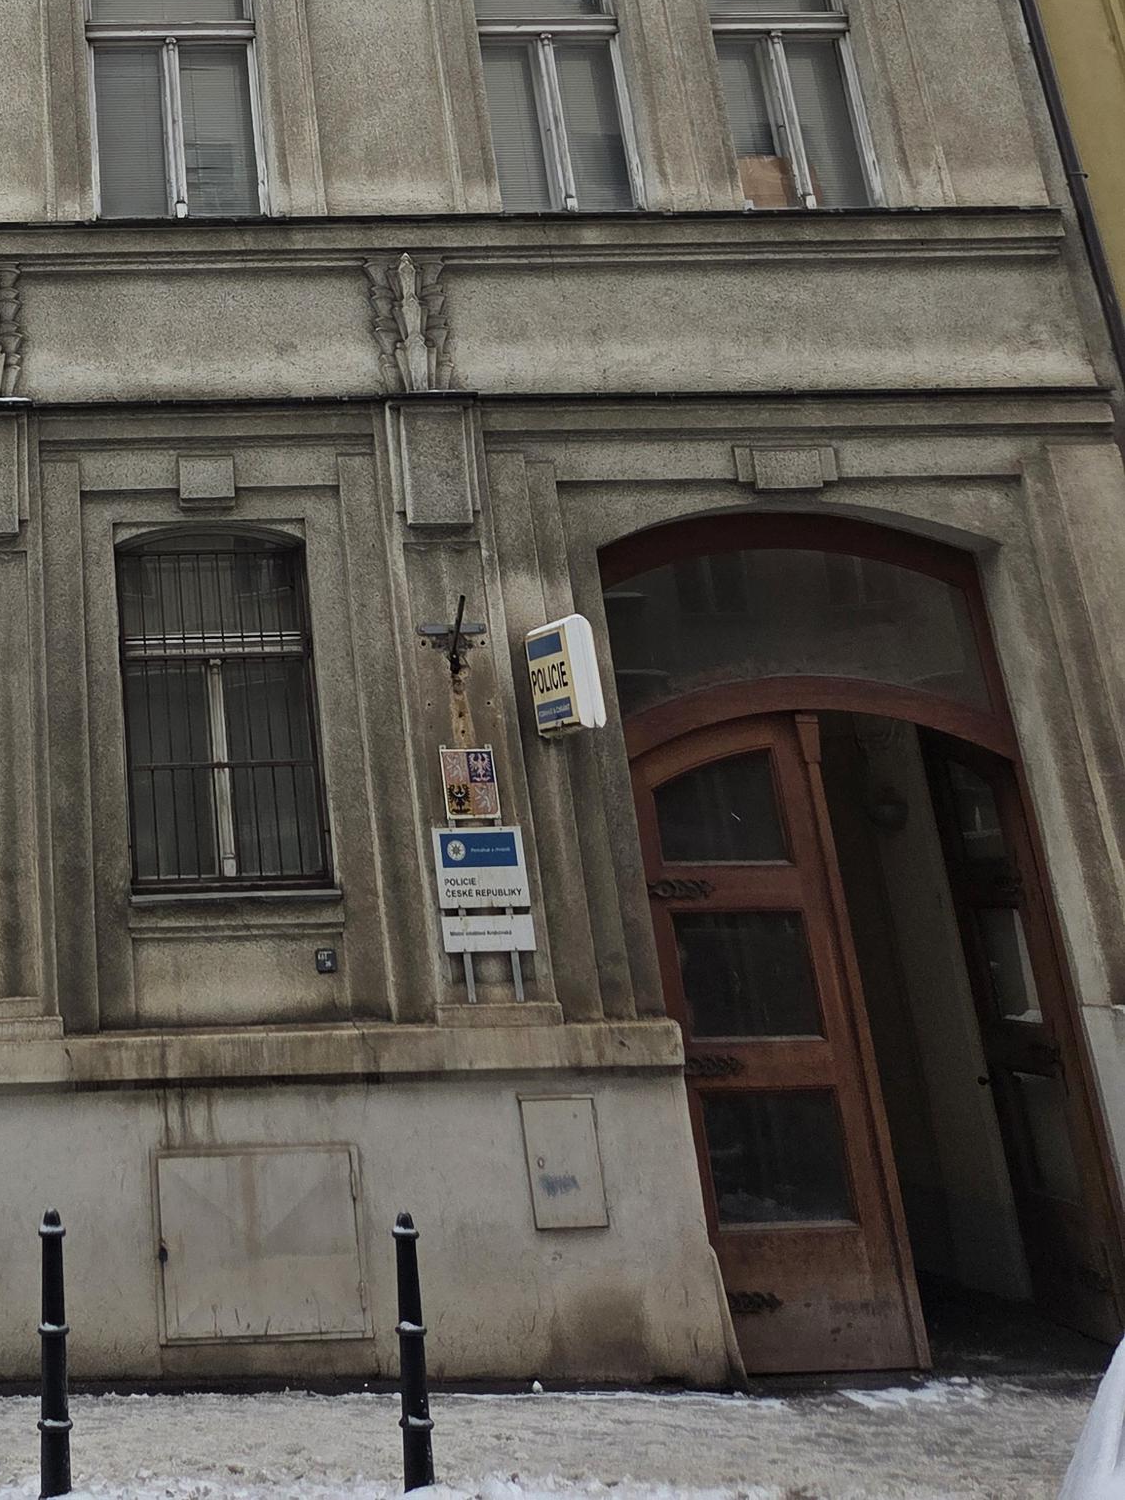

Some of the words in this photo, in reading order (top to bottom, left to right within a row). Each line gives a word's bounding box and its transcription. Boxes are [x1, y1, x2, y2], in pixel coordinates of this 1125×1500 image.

[531, 661, 568, 695] POLICIE
[444, 877, 477, 886] POLICIE
[445, 888, 474, 898] ČESKÉ
[475, 888, 522, 897] REPUBLIKY
